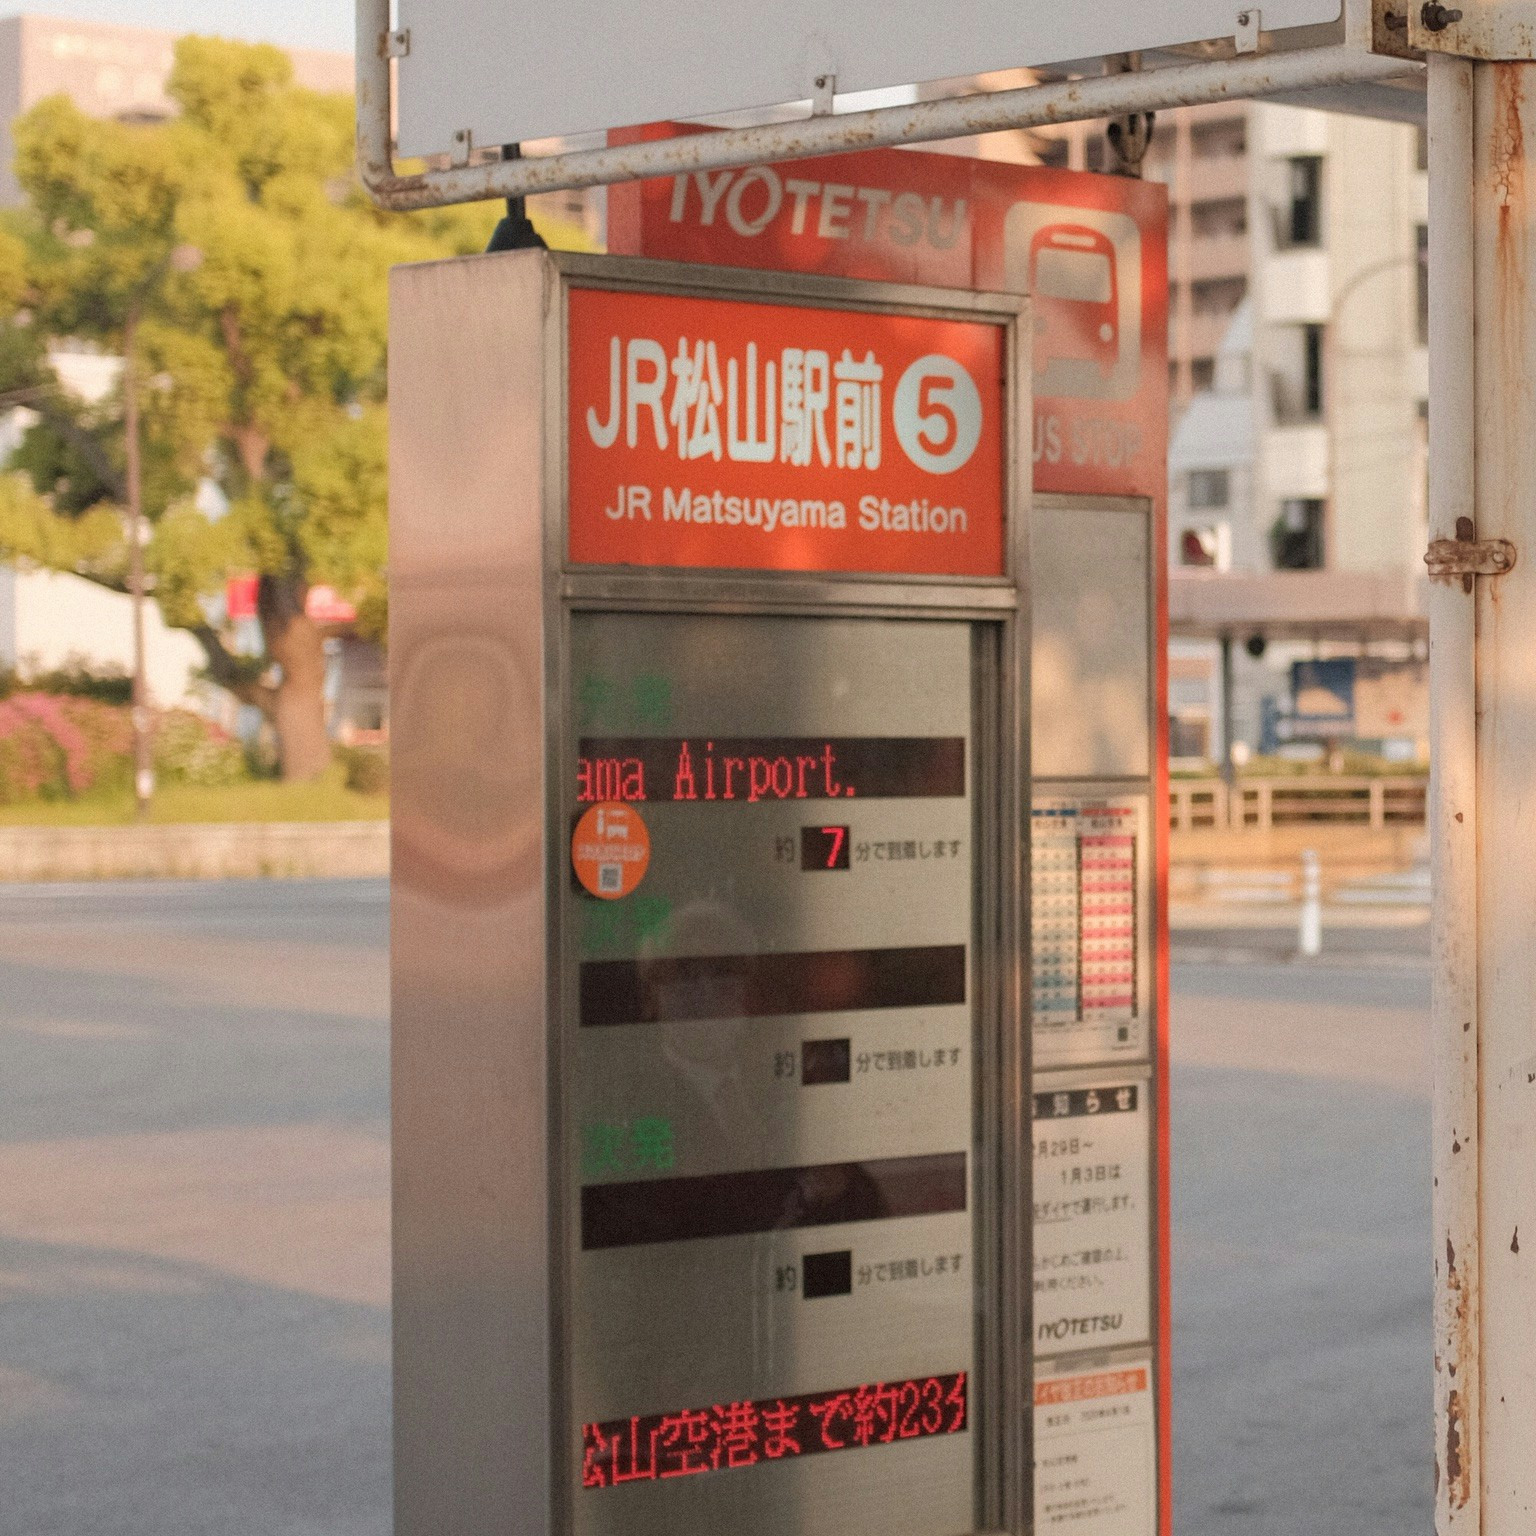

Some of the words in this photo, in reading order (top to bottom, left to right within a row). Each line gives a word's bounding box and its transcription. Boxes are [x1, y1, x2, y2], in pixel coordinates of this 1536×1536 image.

[669, 164, 968, 250] IYOTETSU
[586, 336, 884, 470] JR松山駅前
[1070, 416, 1143, 468] STOP
[605, 484, 653, 521] JR
[663, 487, 847, 533] Matsuyama
[858, 495, 969, 534] Station
[673, 741, 855, 803] Airport.
[821, 826, 845, 868] 7
[1033, 1088, 1131, 1116] 知らせ
[1037, 1313, 1124, 1340] IYOTETSU
